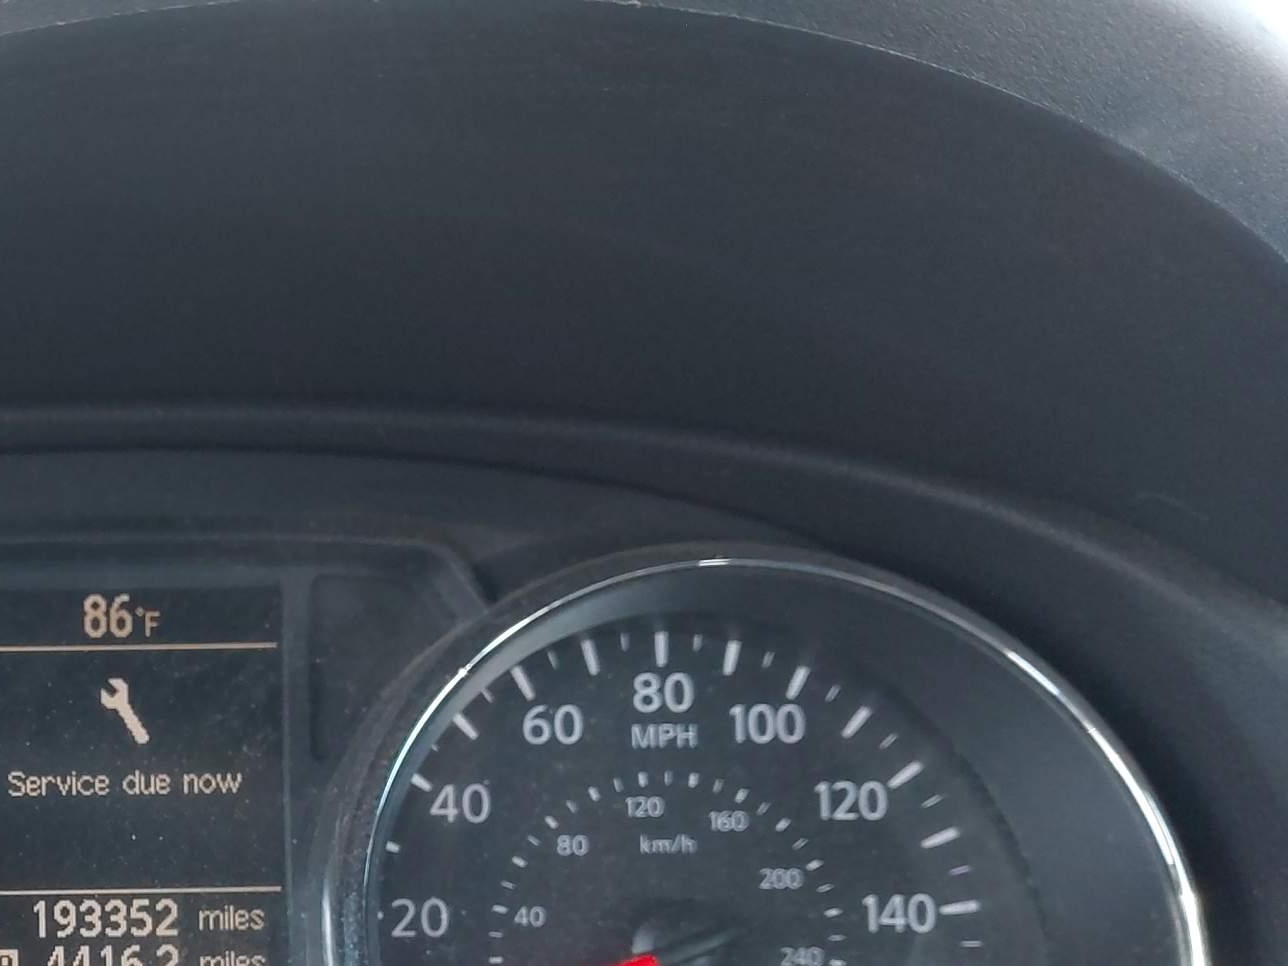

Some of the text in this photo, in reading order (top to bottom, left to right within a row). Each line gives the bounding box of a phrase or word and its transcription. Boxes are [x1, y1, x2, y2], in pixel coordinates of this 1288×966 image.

[84, 593, 160, 638] 86°F
[633, 672, 694, 714] 80
[523, 705, 583, 746] 60
[631, 723, 697, 749] MPH
[729, 704, 805, 745] 100
[8, 771, 242, 796] Service due now
[430, 783, 491, 823] 40
[815, 781, 888, 821] 120
[625, 796, 665, 818] 120
[709, 810, 750, 832] 160
[557, 835, 590, 856] 80
[639, 834, 698, 854] km/h
[760, 868, 804, 890] 200
[33, 899, 265, 938] 193352 miles
[391, 898, 450, 938] 20
[514, 906, 546, 929] 40
[862, 894, 937, 934] 140
